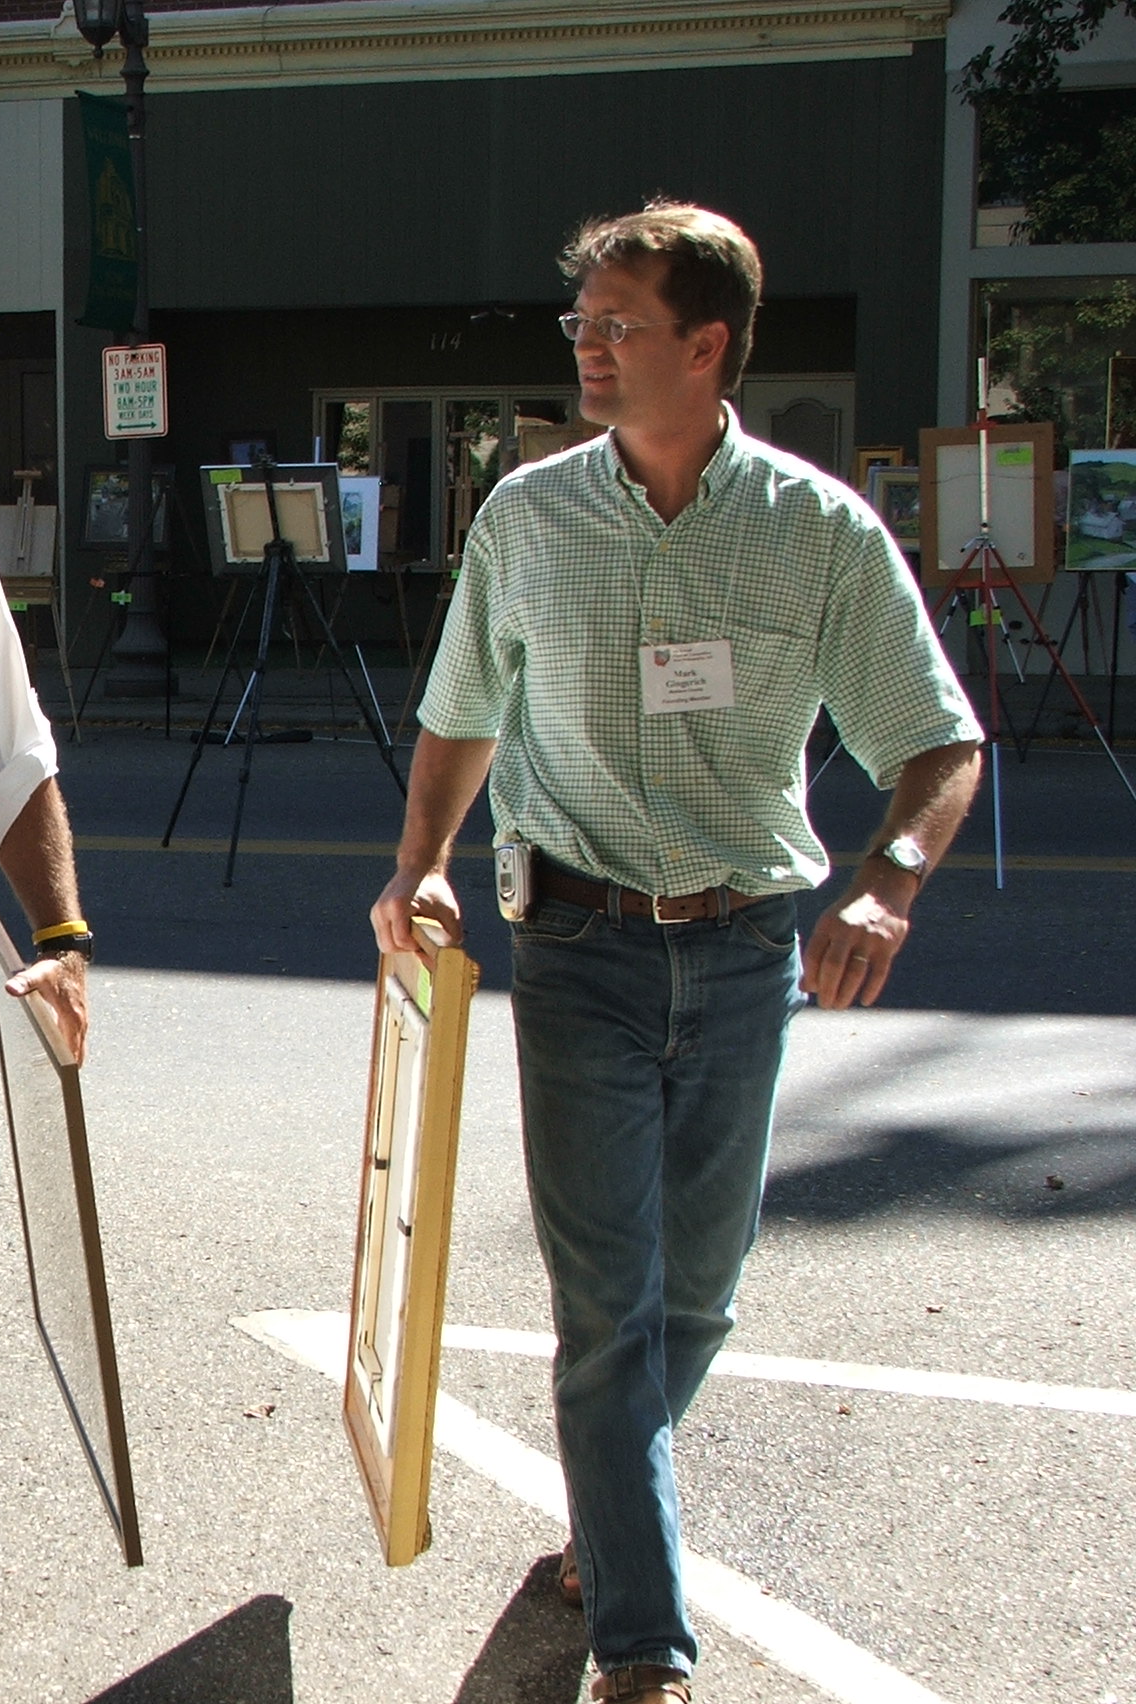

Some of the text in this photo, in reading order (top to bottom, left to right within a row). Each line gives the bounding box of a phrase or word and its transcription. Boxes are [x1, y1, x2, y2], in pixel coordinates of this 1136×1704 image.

[430, 332, 462, 350] 114
[108, 351, 160, 366] NO PARKING
[114, 367, 155, 380] 3AM-5AM
[113, 380, 157, 394] TWO HOUR
[117, 395, 154, 410] 8AM-5PM
[119, 410, 153, 419] WEEK DAYS
[674, 669, 697, 677] Mark
